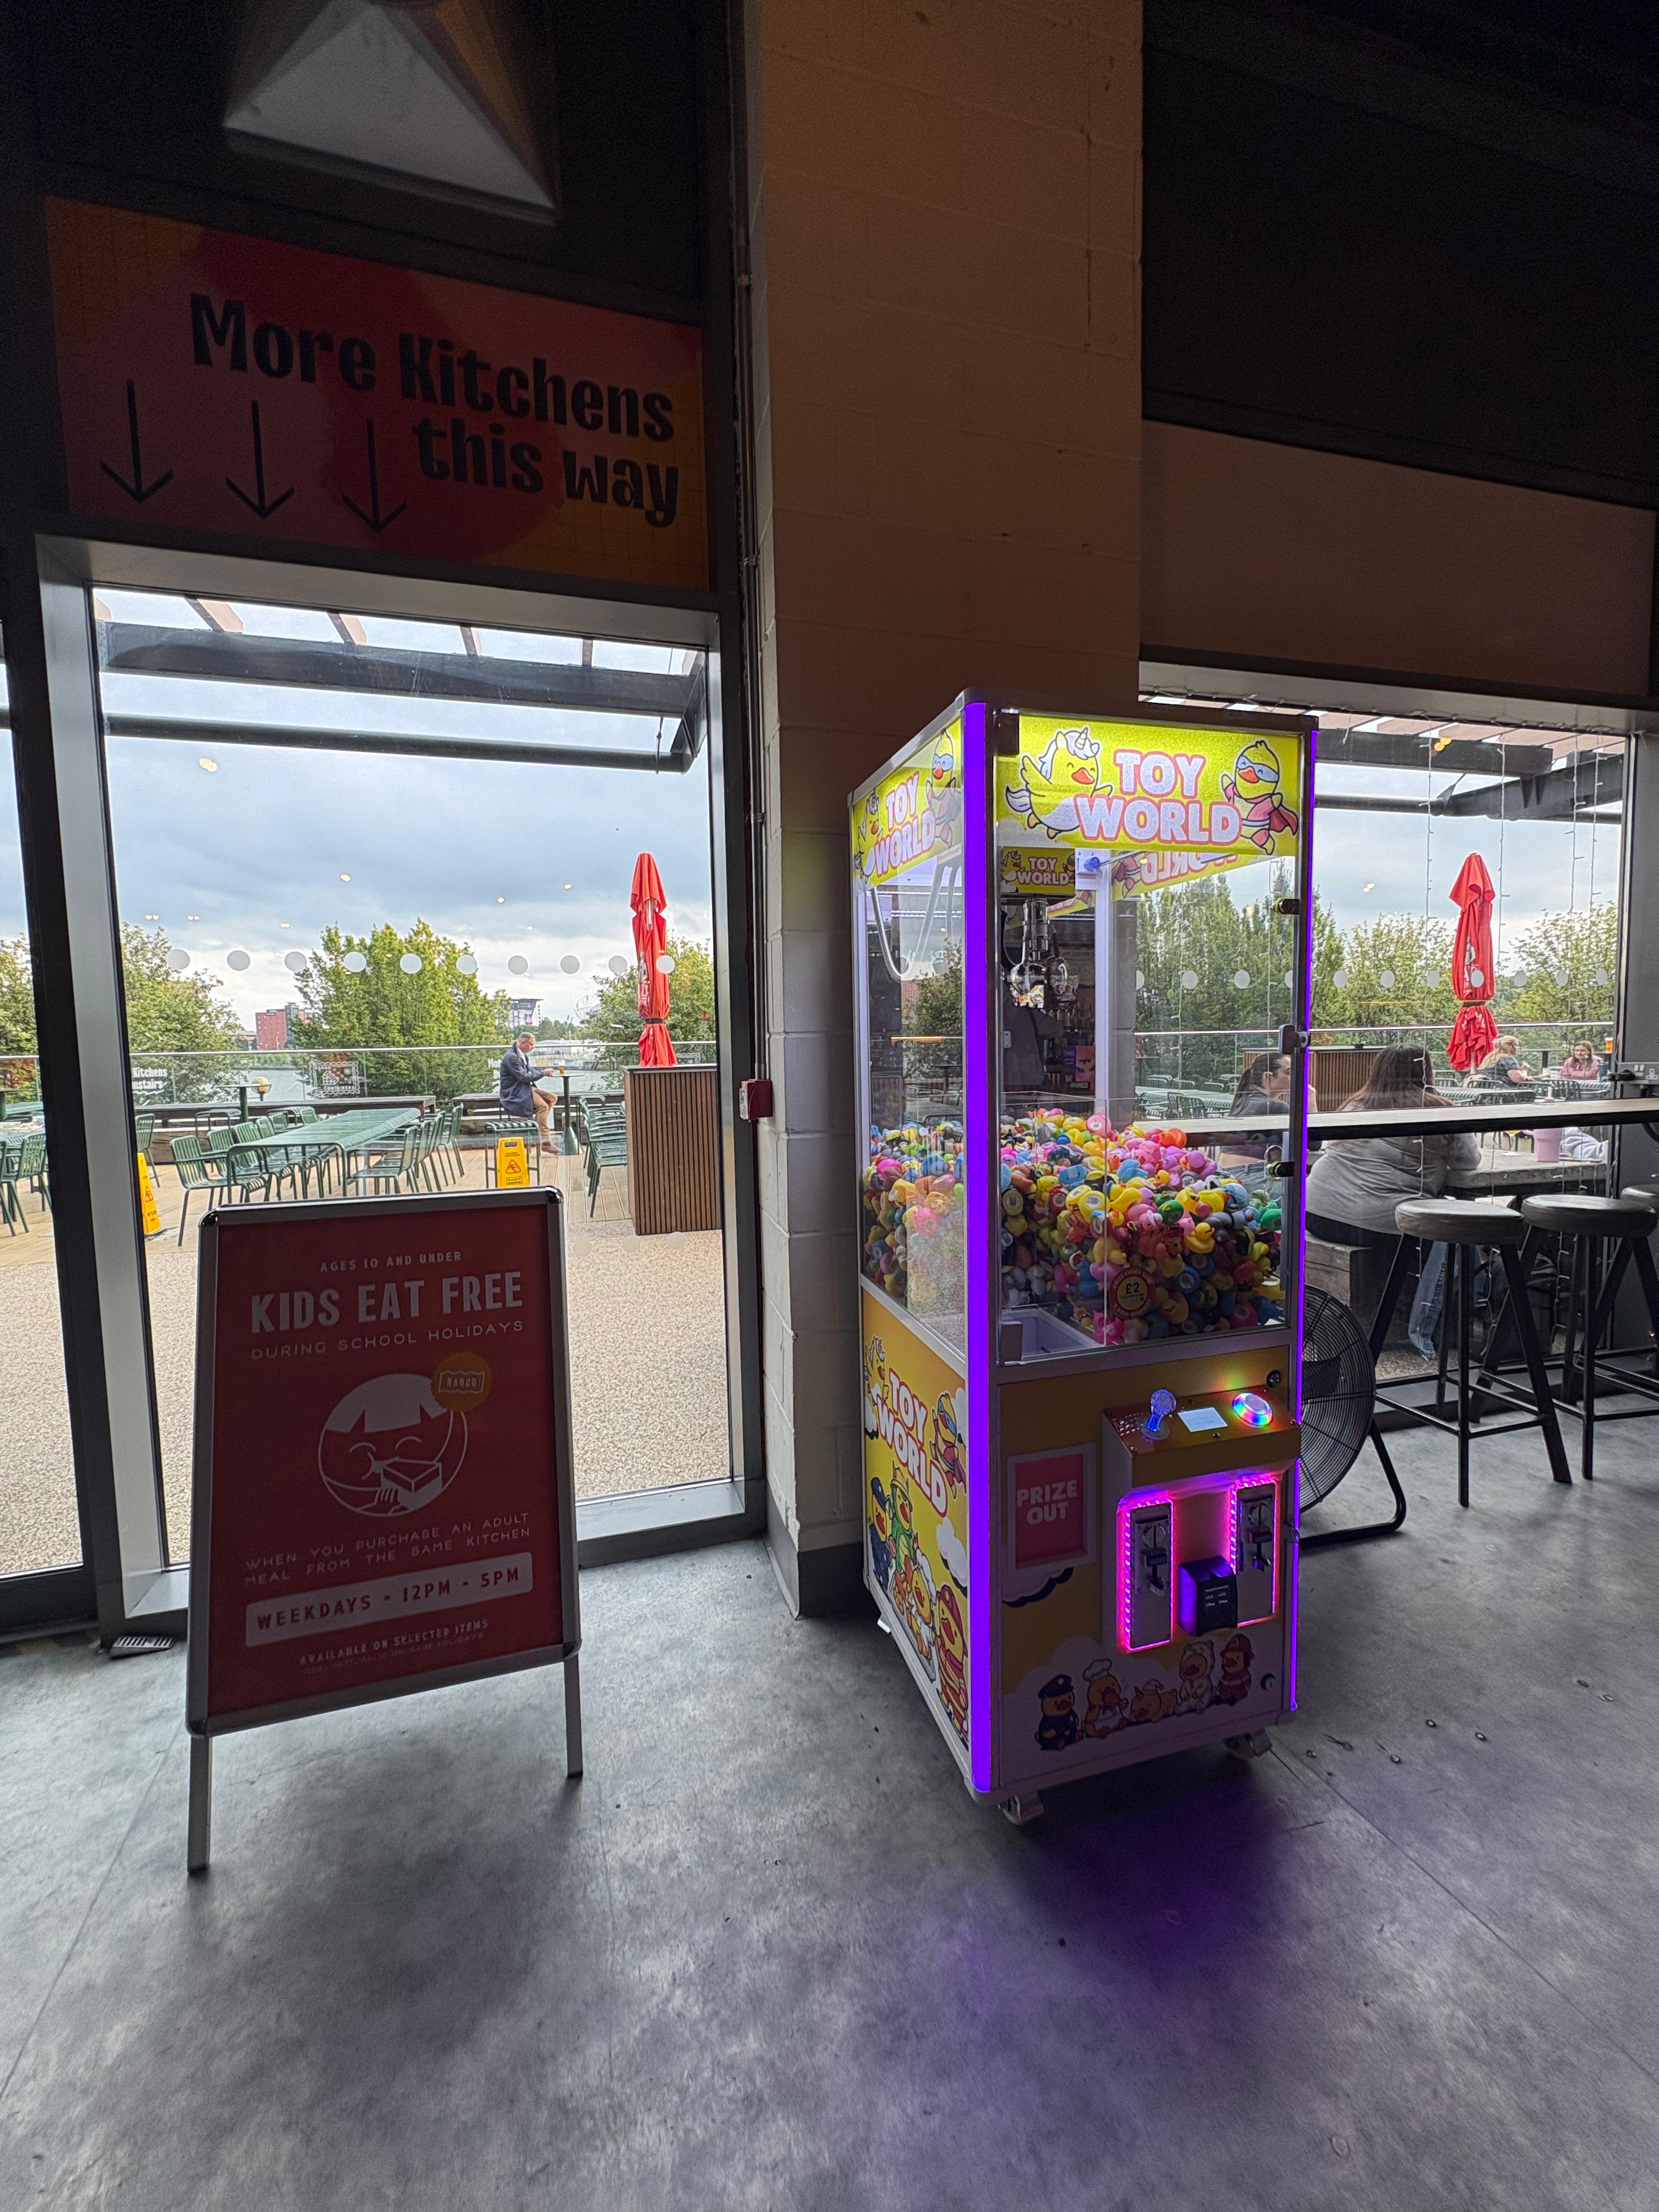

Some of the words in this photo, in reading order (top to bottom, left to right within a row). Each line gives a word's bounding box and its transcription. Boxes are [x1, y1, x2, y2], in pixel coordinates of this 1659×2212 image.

[190, 292, 376, 392] More
[398, 332, 675, 442] Kitchens
[412, 417, 543, 493] this
[562, 448, 679, 528] way
[885, 772, 920, 824] TOY
[1114, 749, 1206, 798] TOY
[874, 808, 935, 877] WORLD
[1074, 794, 1242, 844] WORLD
[1017, 870, 1070, 885] WORLD
[1029, 856, 1058, 871] TOY
[132, 1067, 167, 1077] Kitchens
[132, 1079, 163, 1090] nstairs
[488, 1058, 502, 1068] Mor
[321, 1260, 357, 1273] AGES
[364, 1258, 379, 1268] 10
[387, 1255, 412, 1266] AND
[419, 1251, 462, 1263] UNDER
[251, 1288, 341, 1334] KIDS
[358, 1280, 425, 1323] EAT
[442, 1271, 523, 1314] FREE
[1125, 1282, 1139, 1294] £2
[251, 1341, 327, 1360] DURING
[338, 1333, 417, 1351] SCHOOL
[428, 1321, 523, 1341] HOLIDAYS
[889, 1369, 928, 1438] TOY
[877, 1394, 947, 1517] WORLD
[1017, 1481, 1077, 1508] PRIZE
[1026, 1503, 1068, 1526] OUT
[245, 1571, 290, 1586] MEAL
[307, 1557, 350, 1574] FROM
[365, 1549, 396, 1564] THE
[412, 1541, 453, 1556] SAME
[467, 1528, 531, 1545] KITCHEN
[246, 1552, 297, 1570] WHEN
[309, 1544, 344, 1559] YOU
[356, 1527, 439, 1551] PURCHASE
[451, 1522, 471, 1536] AN
[483, 1513, 530, 1528] ADULT
[257, 1594, 371, 1630] WEEKDAYS
[403, 1578, 451, 1603] 12PM
[480, 1566, 520, 1589] 5PM
[299, 1644, 367, 1666] AVAILABLE
[374, 1639, 388, 1649] ON
[393, 1626, 450, 1646] SELECTED
[454, 1619, 489, 1634] ITEMS
